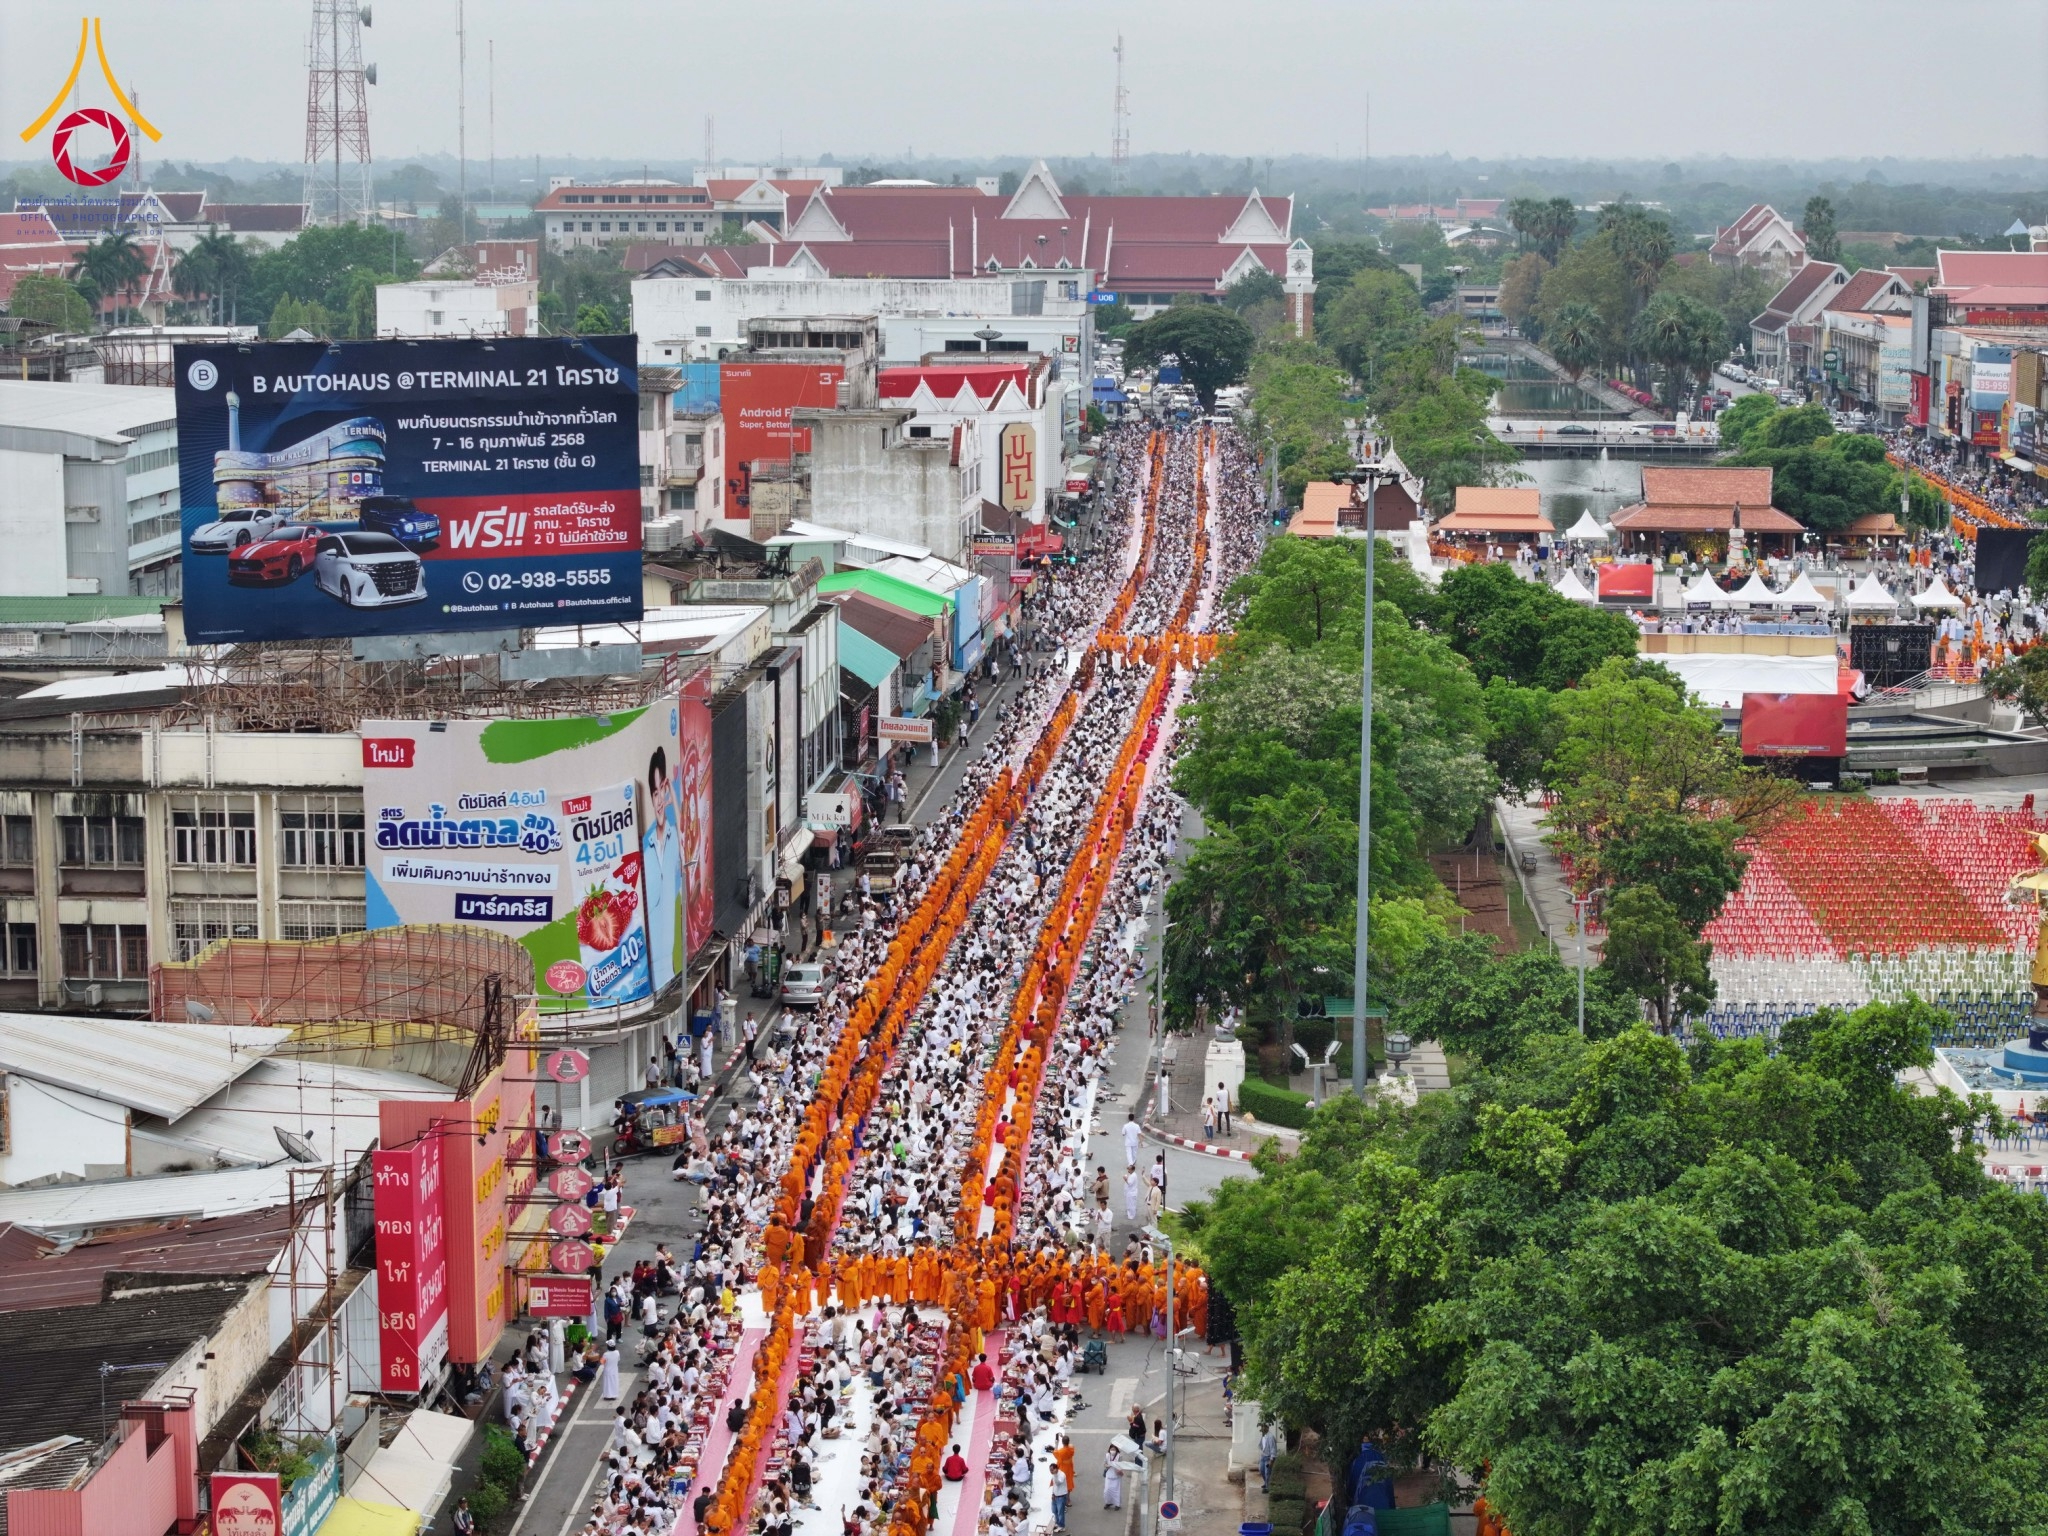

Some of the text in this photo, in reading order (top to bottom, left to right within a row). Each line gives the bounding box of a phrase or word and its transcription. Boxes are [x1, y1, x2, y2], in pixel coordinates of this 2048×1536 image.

[1098, 294, 1114, 302] UOB
[199, 369, 209, 380] B
[253, 376, 267, 393] B
[273, 372, 390, 393] AUTOHAUS
[527, 369, 548, 386] 21
[556, 366, 619, 386] โคราช
[398, 406, 617, 430] พบกับยนตรกรรมนำเข้าจากทั่วโลก
[740, 408, 782, 417] Android
[740, 421, 764, 429] Super,
[432, 438, 441, 450] 7
[459, 437, 474, 450] 16
[479, 432, 546, 453] กุมภาพันธ์
[551, 433, 585, 446] 2568
[422, 452, 596, 473] TERMINAL 21 โคราช (ชั้น G)
[534, 501, 615, 516] รถสไลด์รับ-ส่ง
[449, 506, 528, 549] ฟรี!!
[534, 519, 562, 530] กทม.
[577, 516, 611, 527] โคราช
[534, 529, 628, 545] 2 ปี ไม่มีค่าใช้จ่าย
[488, 568, 611, 590] 02-938-5555
[451, 596, 631, 613] @Bautohaus B Autohaus Bautohaus.official
[370, 744, 405, 764] ใหม่!
[458, 791, 507, 810] ดัชมิลล์
[568, 800, 588, 813] ใหม่!
[381, 808, 403, 820] สูตร
[524, 813, 551, 831] ลง
[572, 801, 633, 842] ดัชมิลล์
[811, 813, 846, 821] Mikka
[377, 804, 520, 848] ลดน้ำตาล
[522, 832, 560, 851] 40%
[462, 896, 548, 917] มาร์คคริส
[593, 961, 615, 981] น้ำตาล
[595, 966, 622, 991] น้อยกว่า
[376, 1165, 409, 1186] ห้าง
[377, 1220, 412, 1235] ทอง
[419, 1203, 443, 1262] ให้เช่า
[384, 1259, 411, 1282] ไท้
[417, 1260, 447, 1319] โฆษณา
[390, 1356, 411, 1378] ล้ง
